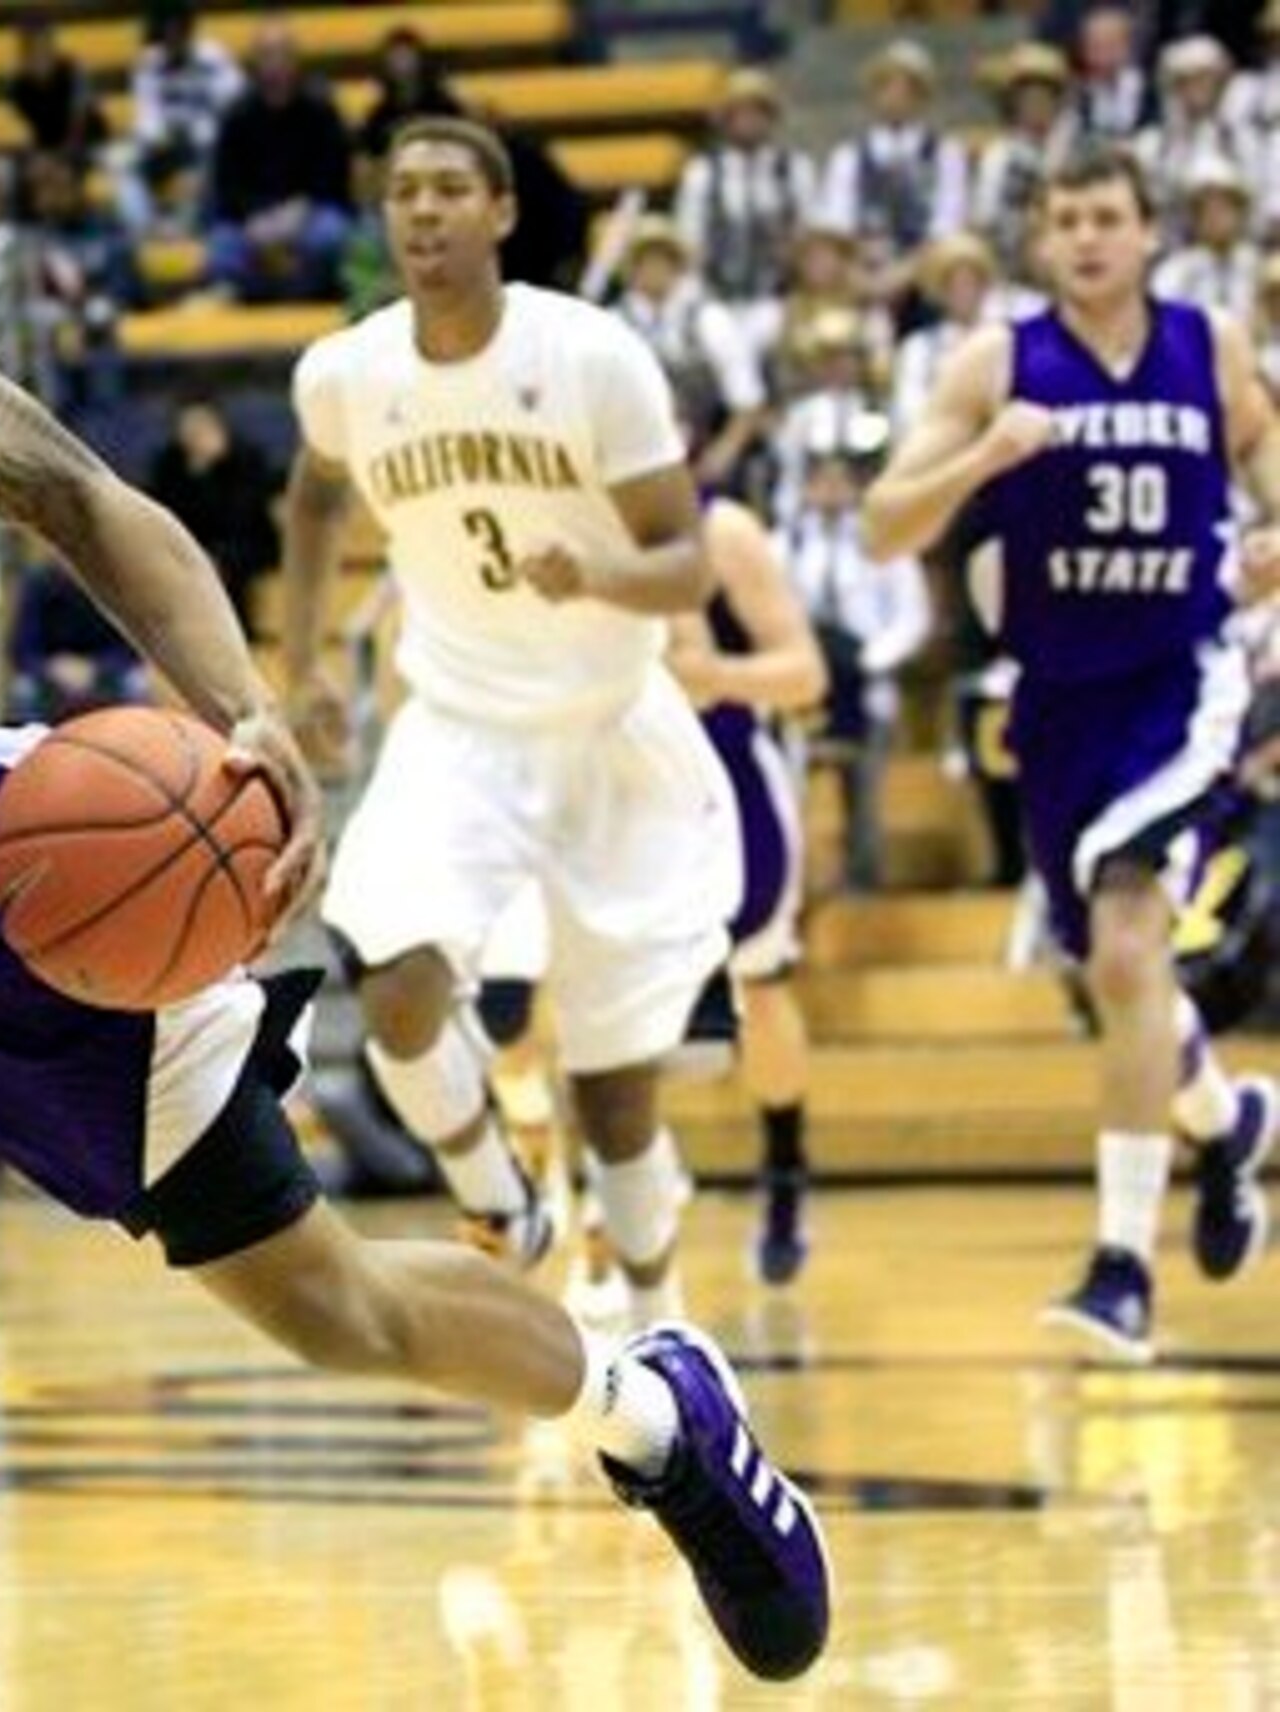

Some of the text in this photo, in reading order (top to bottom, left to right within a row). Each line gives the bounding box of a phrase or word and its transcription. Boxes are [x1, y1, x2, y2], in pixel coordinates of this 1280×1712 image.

[370, 428, 582, 507] CALIFORNIA
[1085, 463, 1167, 534] 30
[463, 506, 516, 593] 3
[1048, 547, 1193, 593] STATE
